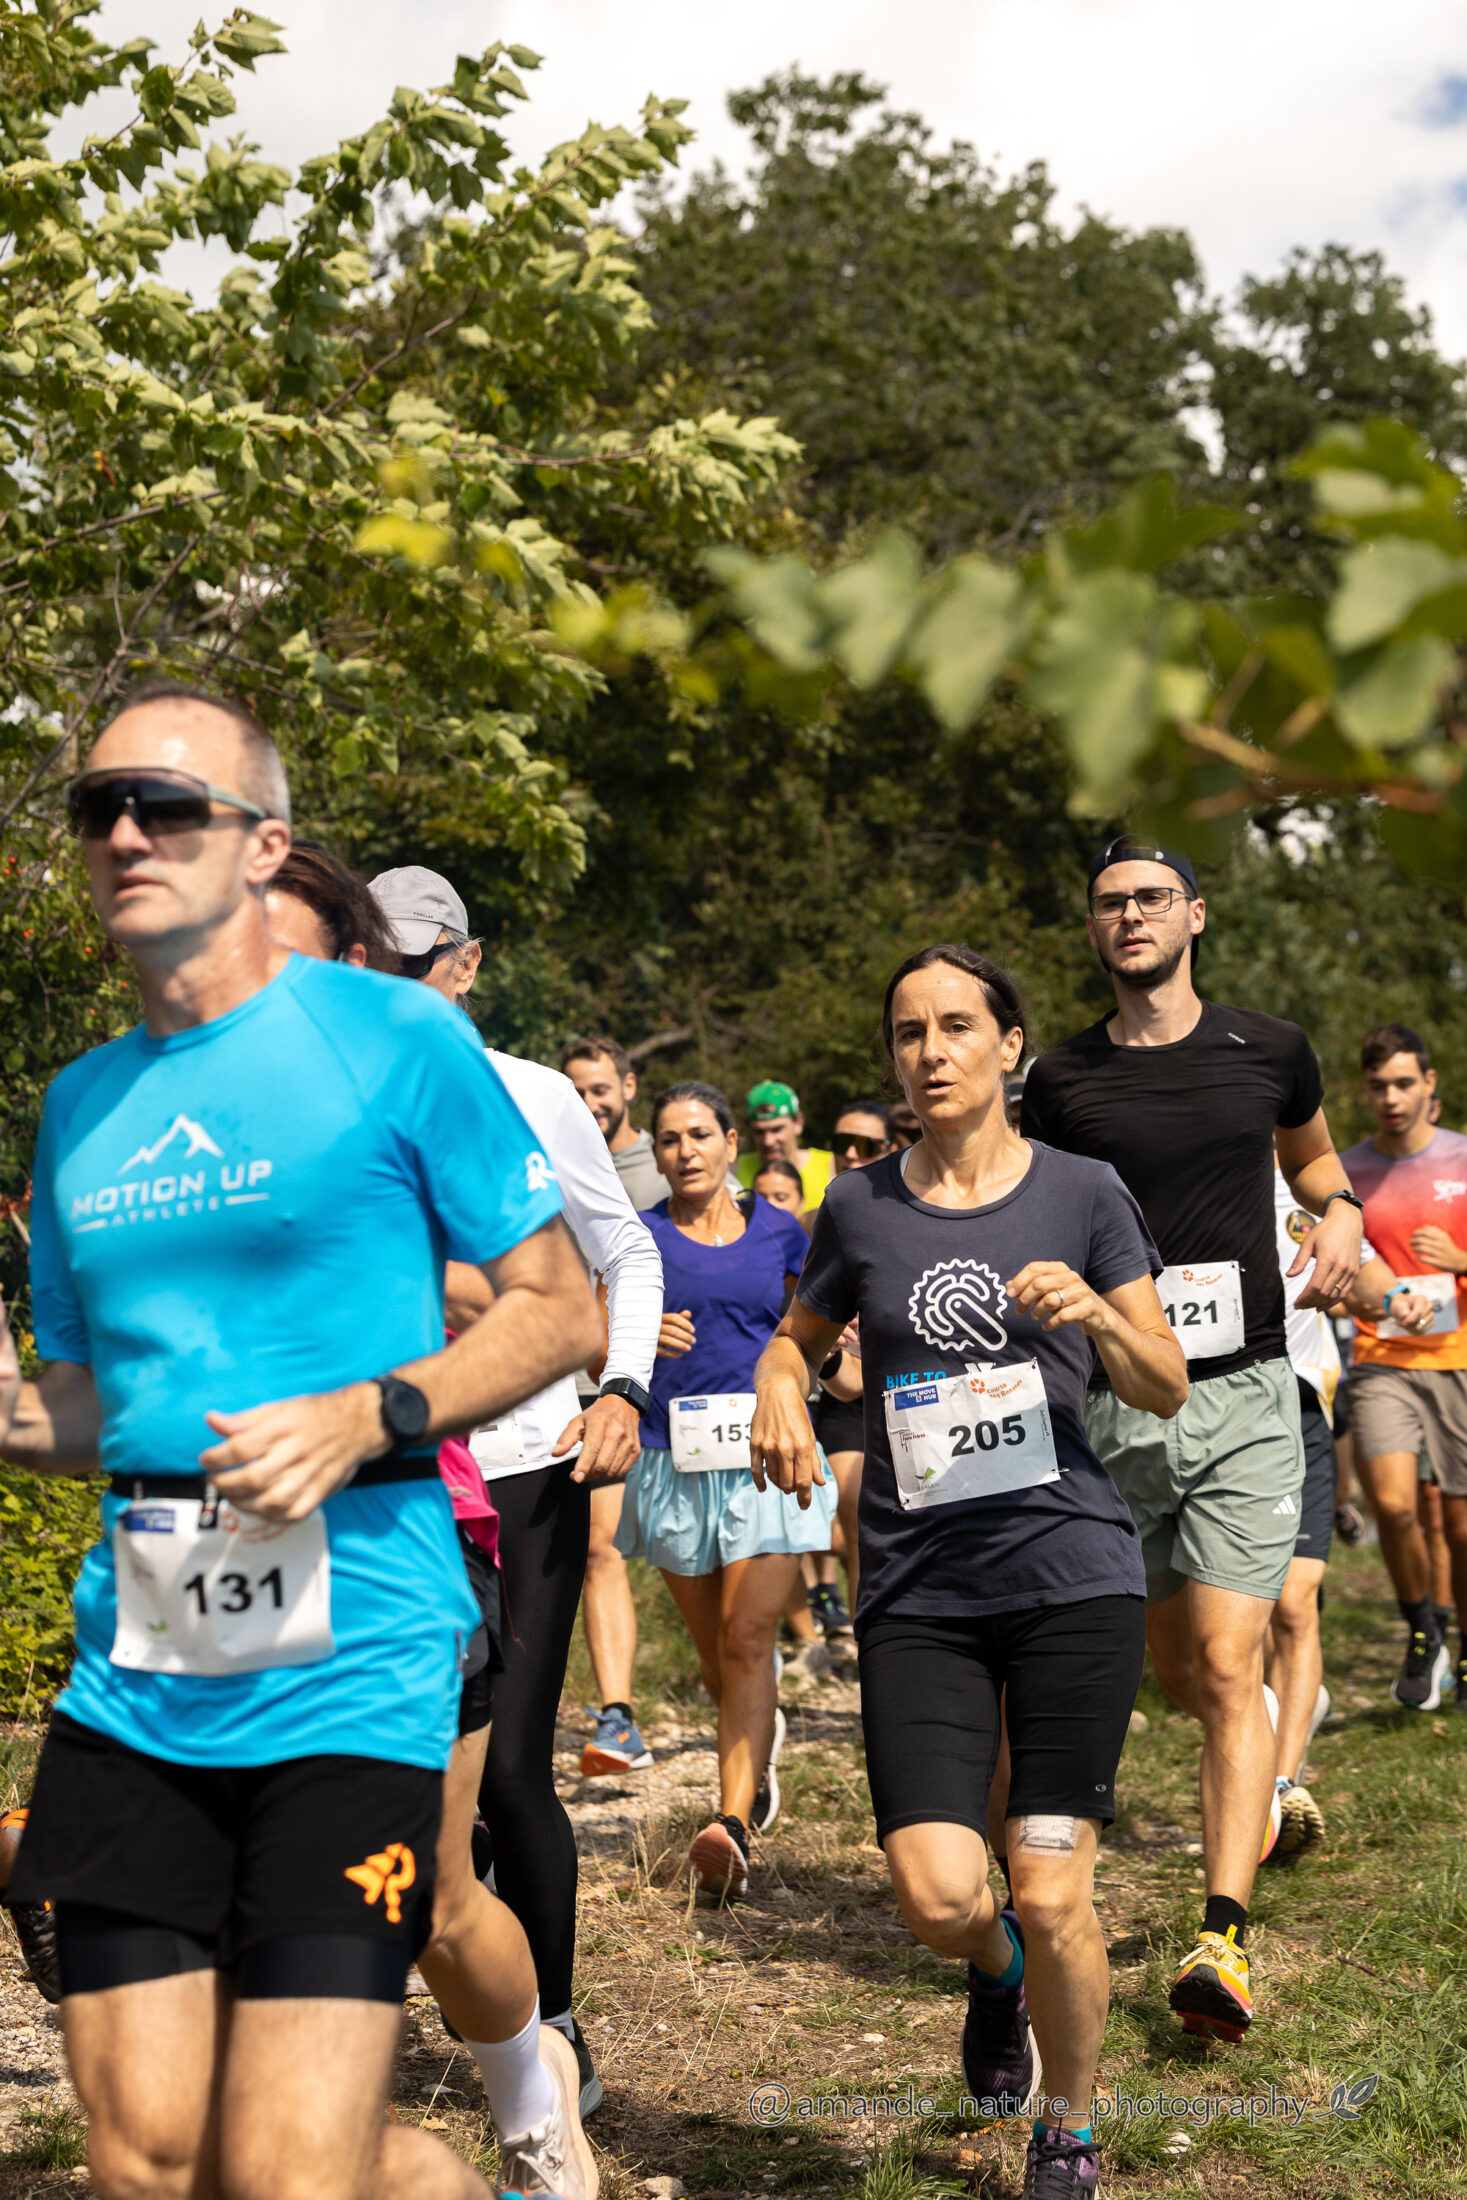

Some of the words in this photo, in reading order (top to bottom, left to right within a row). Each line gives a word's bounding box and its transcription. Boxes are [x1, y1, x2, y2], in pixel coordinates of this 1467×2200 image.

[70, 1169, 206, 1220] MOTION
[220, 1159, 273, 1191] UP
[111, 1196, 219, 1227] ATHLETE
[1164, 1300, 1218, 1327] 121
[886, 1372, 919, 1389] BIKE
[923, 1370, 947, 1381] TO
[906, 1391, 918, 1399] THE
[918, 1387, 936, 1397] MOVE
[923, 1393, 937, 1401] HUB
[948, 1413, 1026, 1458] 205
[184, 1566, 284, 1615] 131
